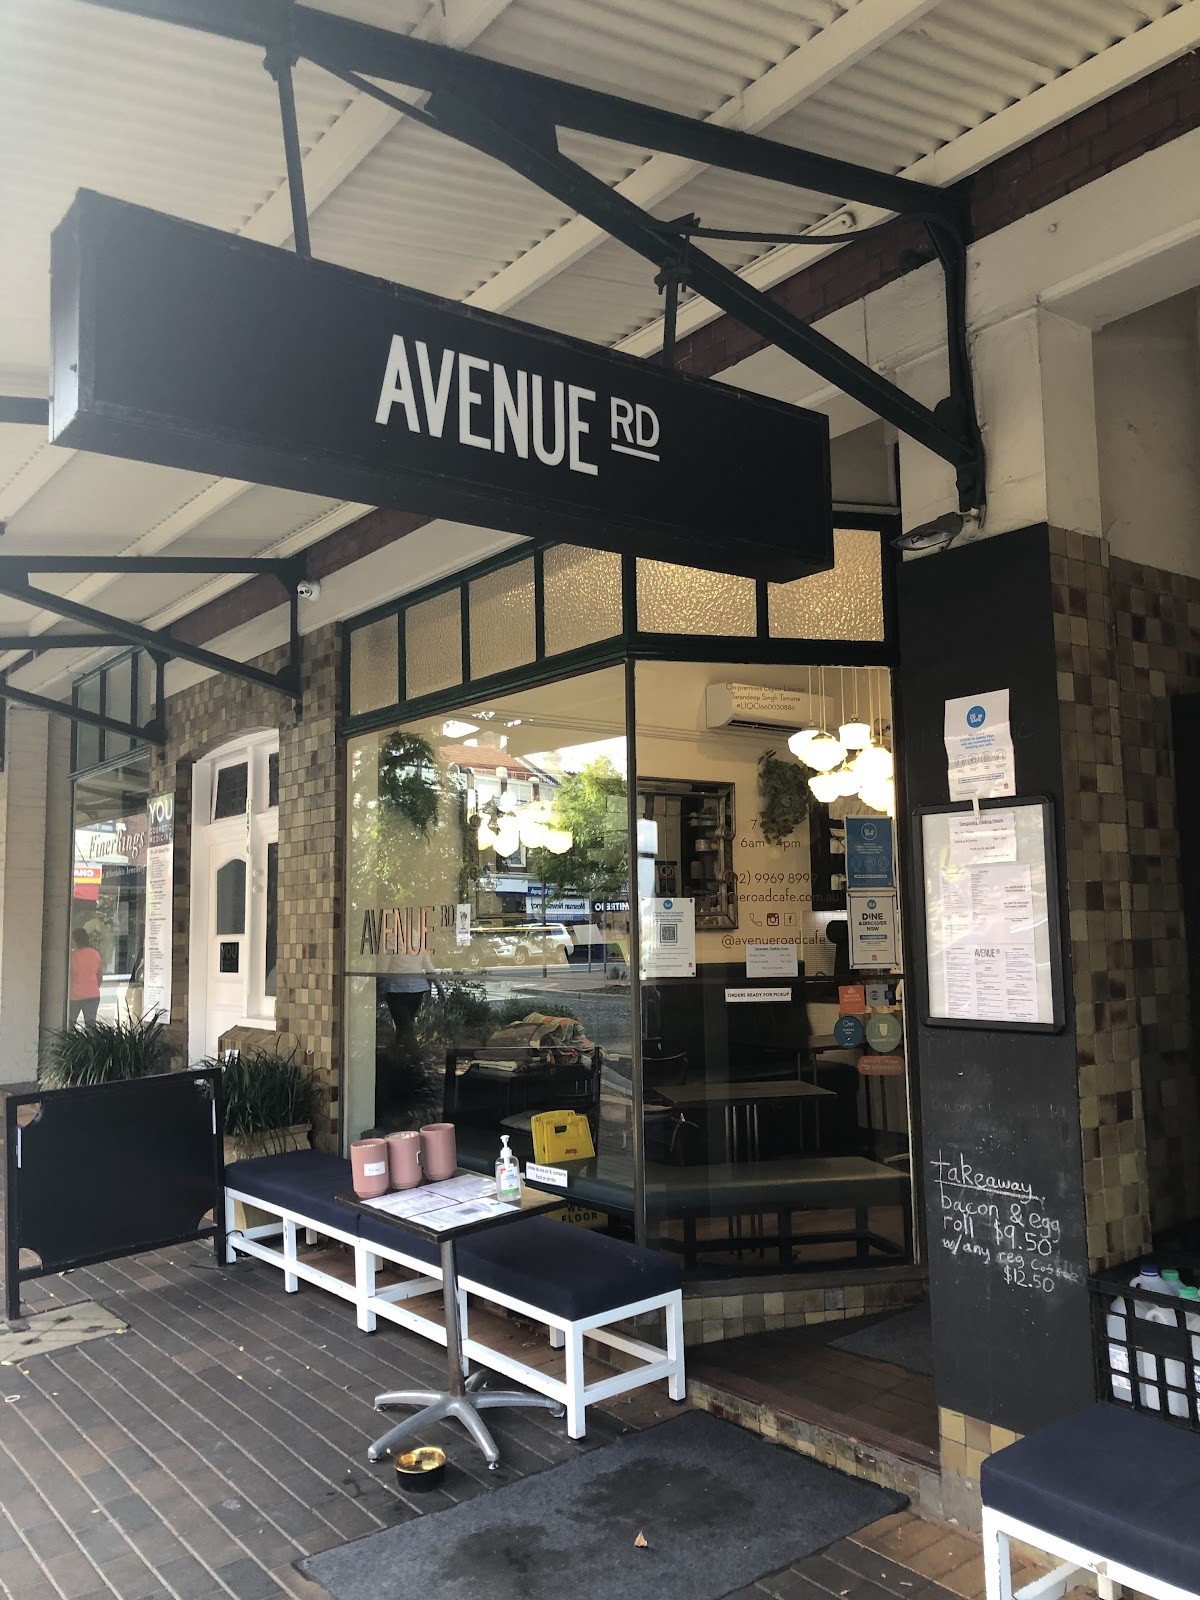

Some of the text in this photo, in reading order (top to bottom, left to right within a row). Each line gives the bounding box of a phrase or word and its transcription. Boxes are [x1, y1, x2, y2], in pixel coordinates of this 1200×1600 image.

[374, 333, 660, 476] AVENUE RD
[762, 693, 778, 702] Singh
[149, 798, 173, 824] YOU
[750, 819, 757, 830] 7
[740, 837, 765, 848] 6am
[754, 872, 785, 884] 9969
[360, 906, 435, 956] AVENUE
[721, 929, 826, 949] @avenueroadcafe
[974, 949, 996, 958] AVENUE
[561, 1212, 598, 1223] FLOOR
[941, 1195, 1061, 1244] bacon & egg
[943, 1212, 1052, 1256] roll $9.50
[998, 1251, 1025, 1269] reg
[1003, 1264, 1055, 1293] $12.50
